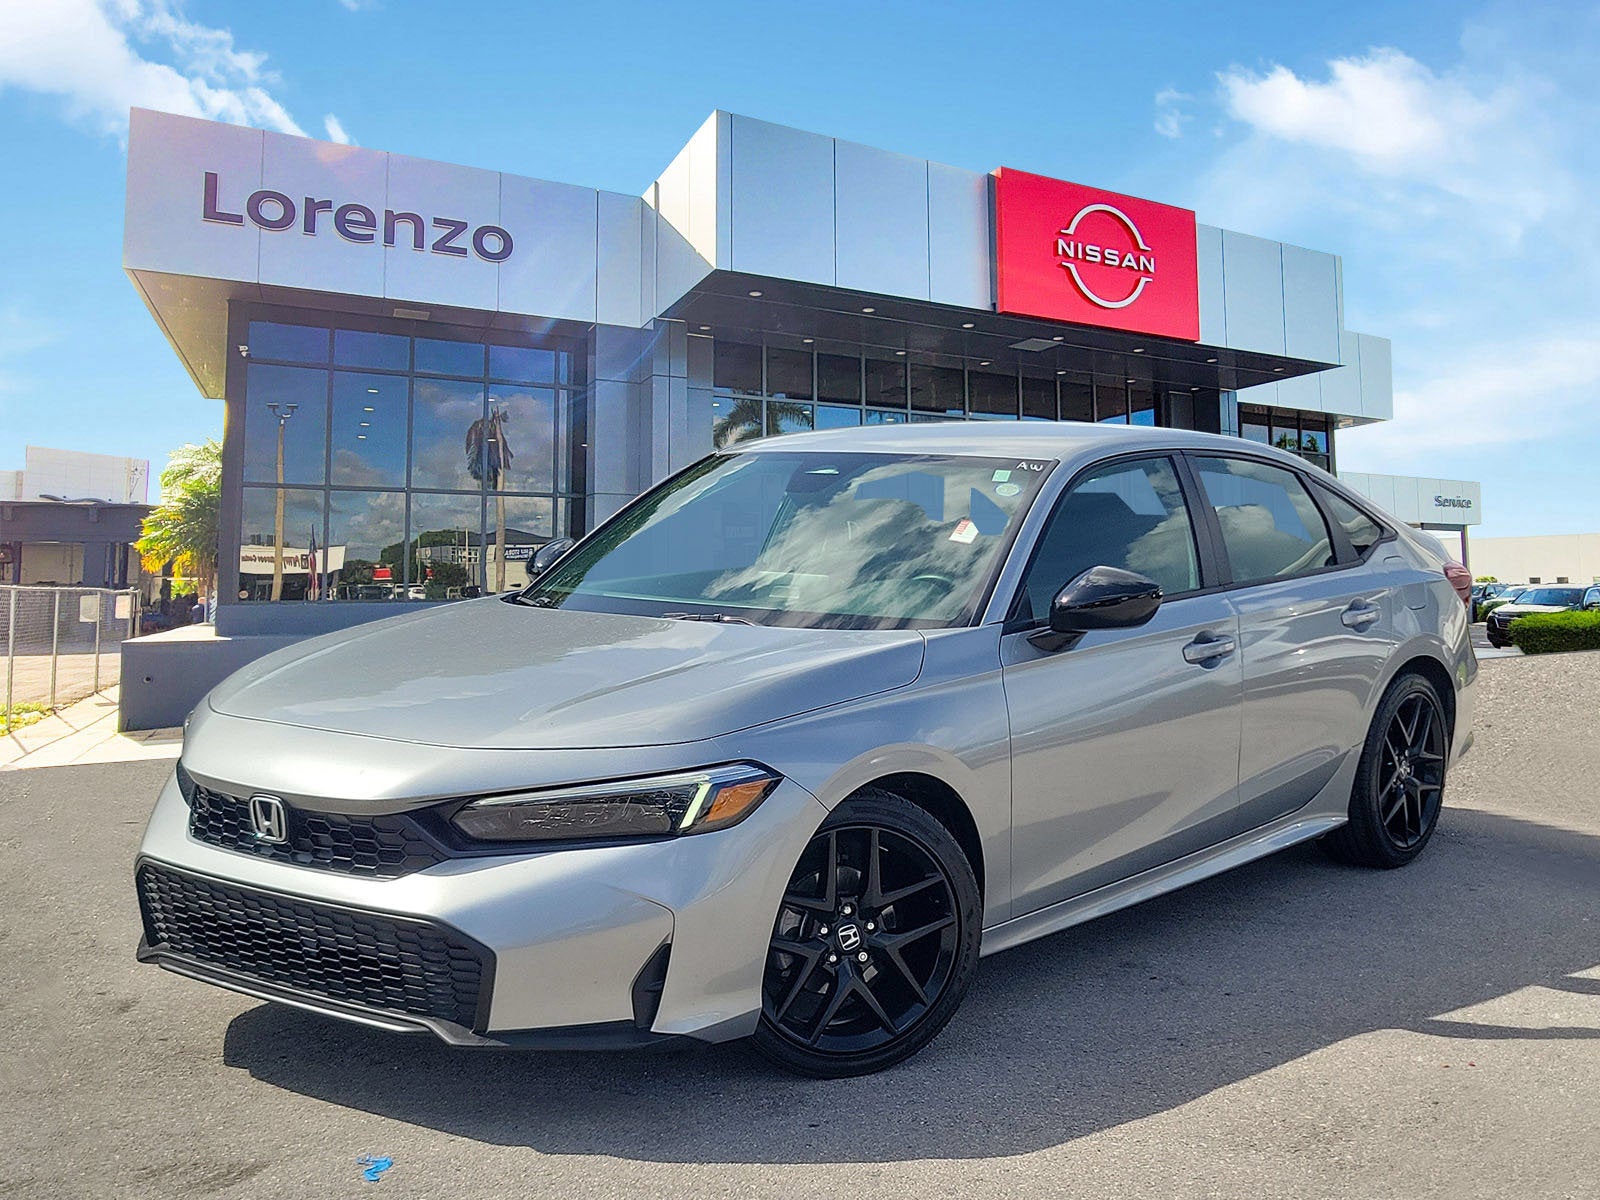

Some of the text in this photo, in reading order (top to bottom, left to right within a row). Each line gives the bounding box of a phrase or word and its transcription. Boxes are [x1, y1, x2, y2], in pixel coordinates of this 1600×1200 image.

[201, 171, 514, 262] Lorenzo
[1057, 238, 1155, 273] NISSAN
[1435, 496, 1472, 509] Service
